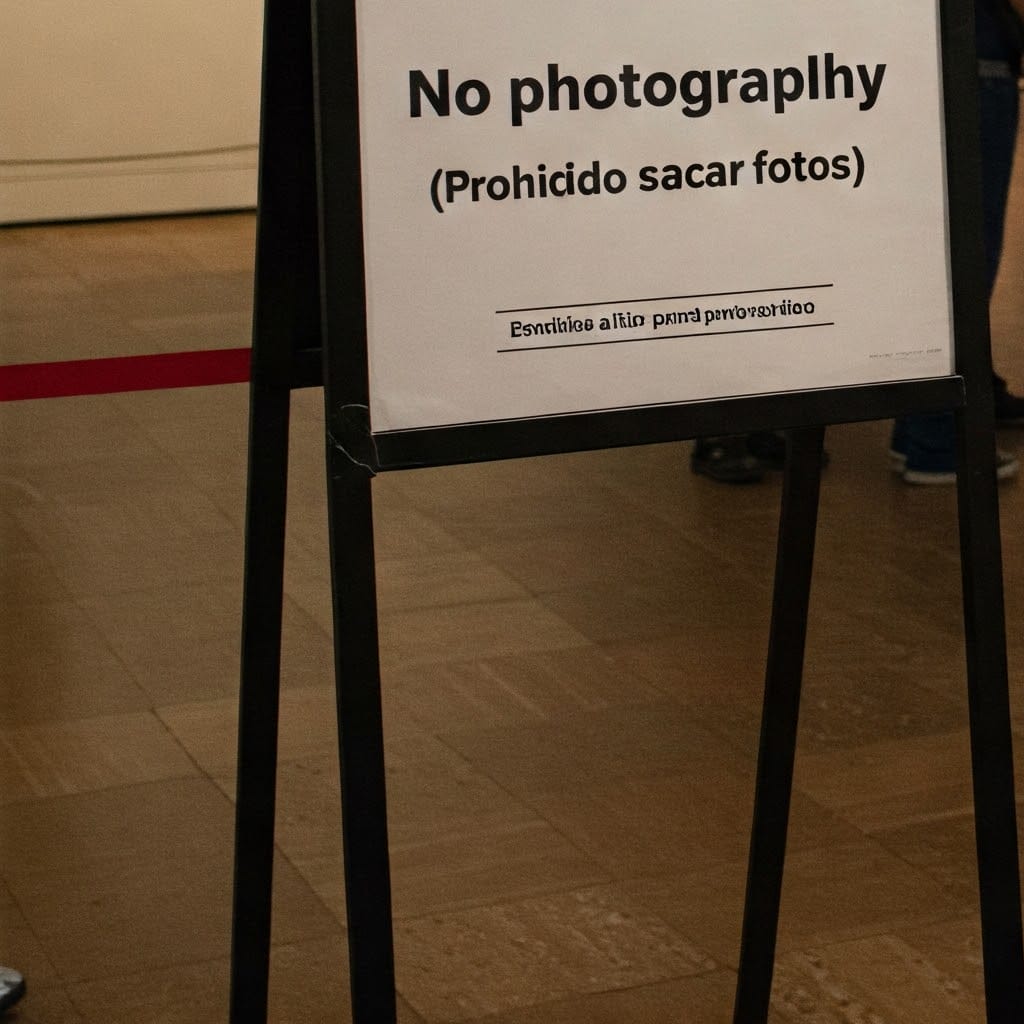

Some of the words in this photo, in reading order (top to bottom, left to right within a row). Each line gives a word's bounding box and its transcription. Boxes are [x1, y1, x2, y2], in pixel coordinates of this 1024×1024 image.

[409, 69, 491, 119] No
[511, 53, 887, 127] photograplhy
[638, 160, 745, 192] sacar
[752, 145, 866, 189] fotos)
